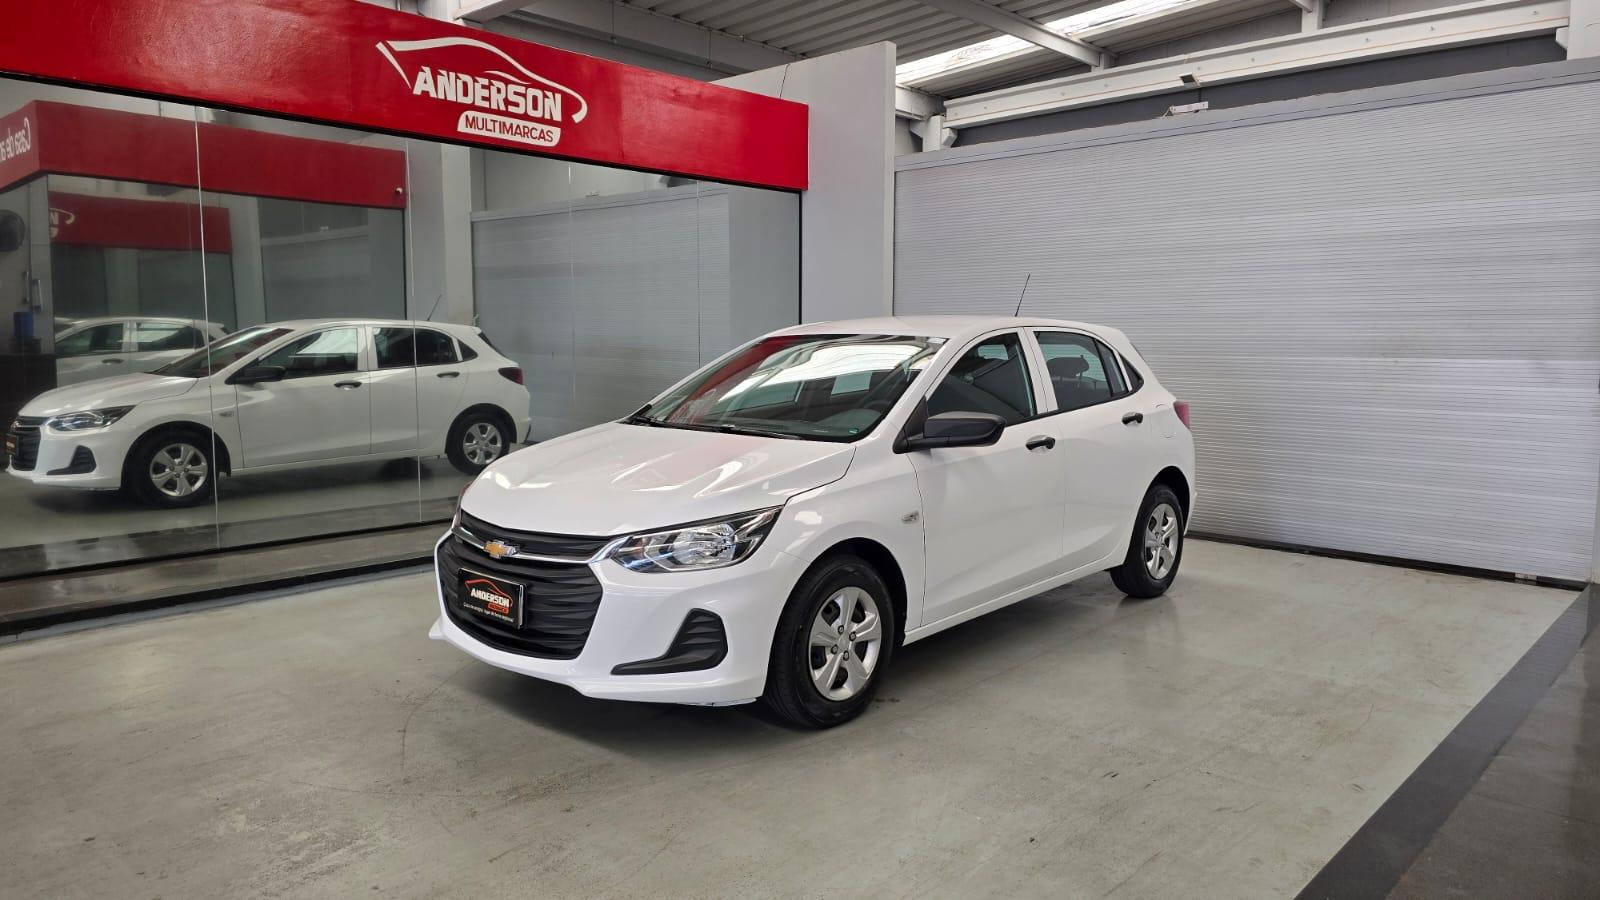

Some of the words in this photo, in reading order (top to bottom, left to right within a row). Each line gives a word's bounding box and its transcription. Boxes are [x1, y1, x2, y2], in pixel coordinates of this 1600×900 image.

[413, 66, 562, 122] ANDERSON
[465, 115, 554, 143] MULTIMARCAS
[470, 587, 510, 608] ANDERSON
